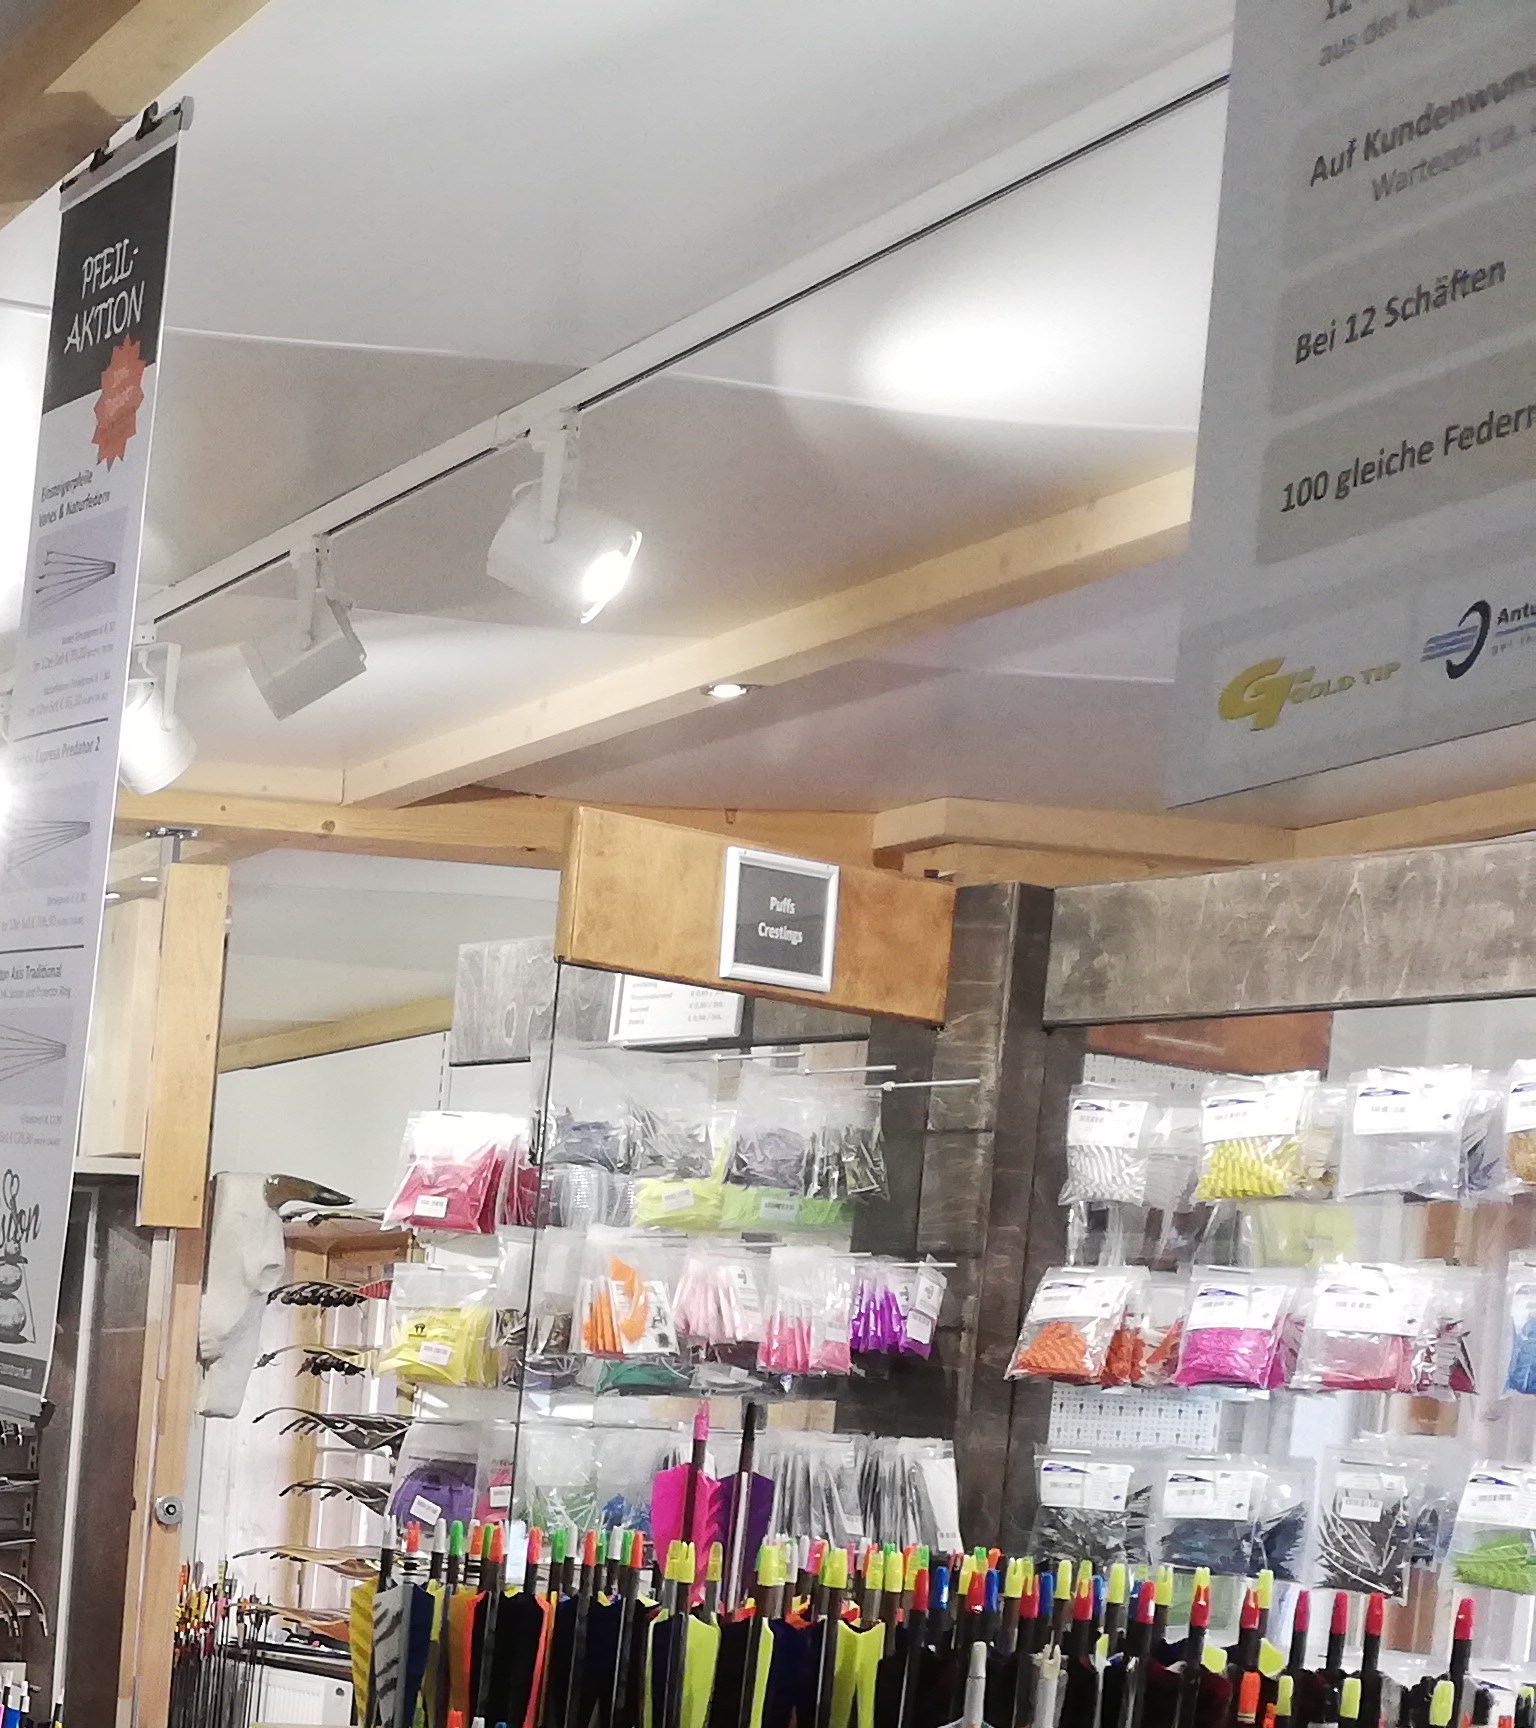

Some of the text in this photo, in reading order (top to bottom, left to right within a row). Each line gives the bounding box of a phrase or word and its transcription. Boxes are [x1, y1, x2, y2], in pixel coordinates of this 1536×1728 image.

[1310, 137, 1358, 187] Auf
[64, 280, 145, 354] AKTION
[1296, 260, 1507, 365] Bei 12 Schäften
[1280, 470, 1329, 512] 100
[1334, 439, 1435, 499] gleiche
[757, 922, 804, 945] Crestings
[769, 896, 796, 914] Puffs
